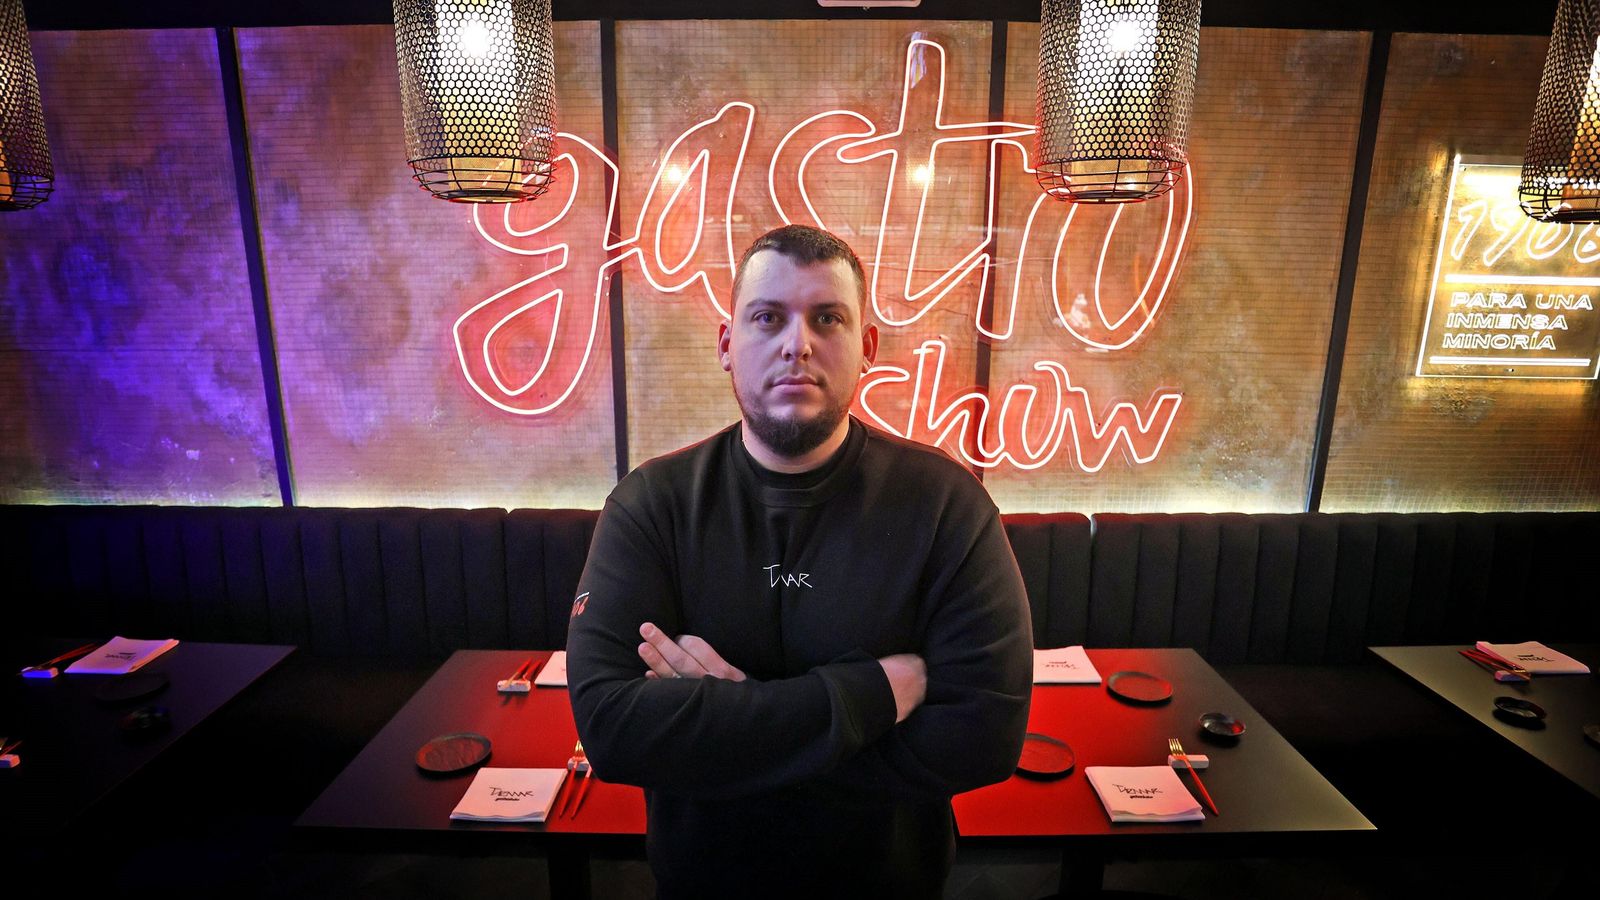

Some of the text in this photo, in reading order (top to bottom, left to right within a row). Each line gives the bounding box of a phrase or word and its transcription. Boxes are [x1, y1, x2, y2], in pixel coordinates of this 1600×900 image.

[1450, 291, 1594, 310] PARA UNA
[1445, 312, 1568, 330] INMENSA
[1441, 331, 1557, 350] MINORÍA
